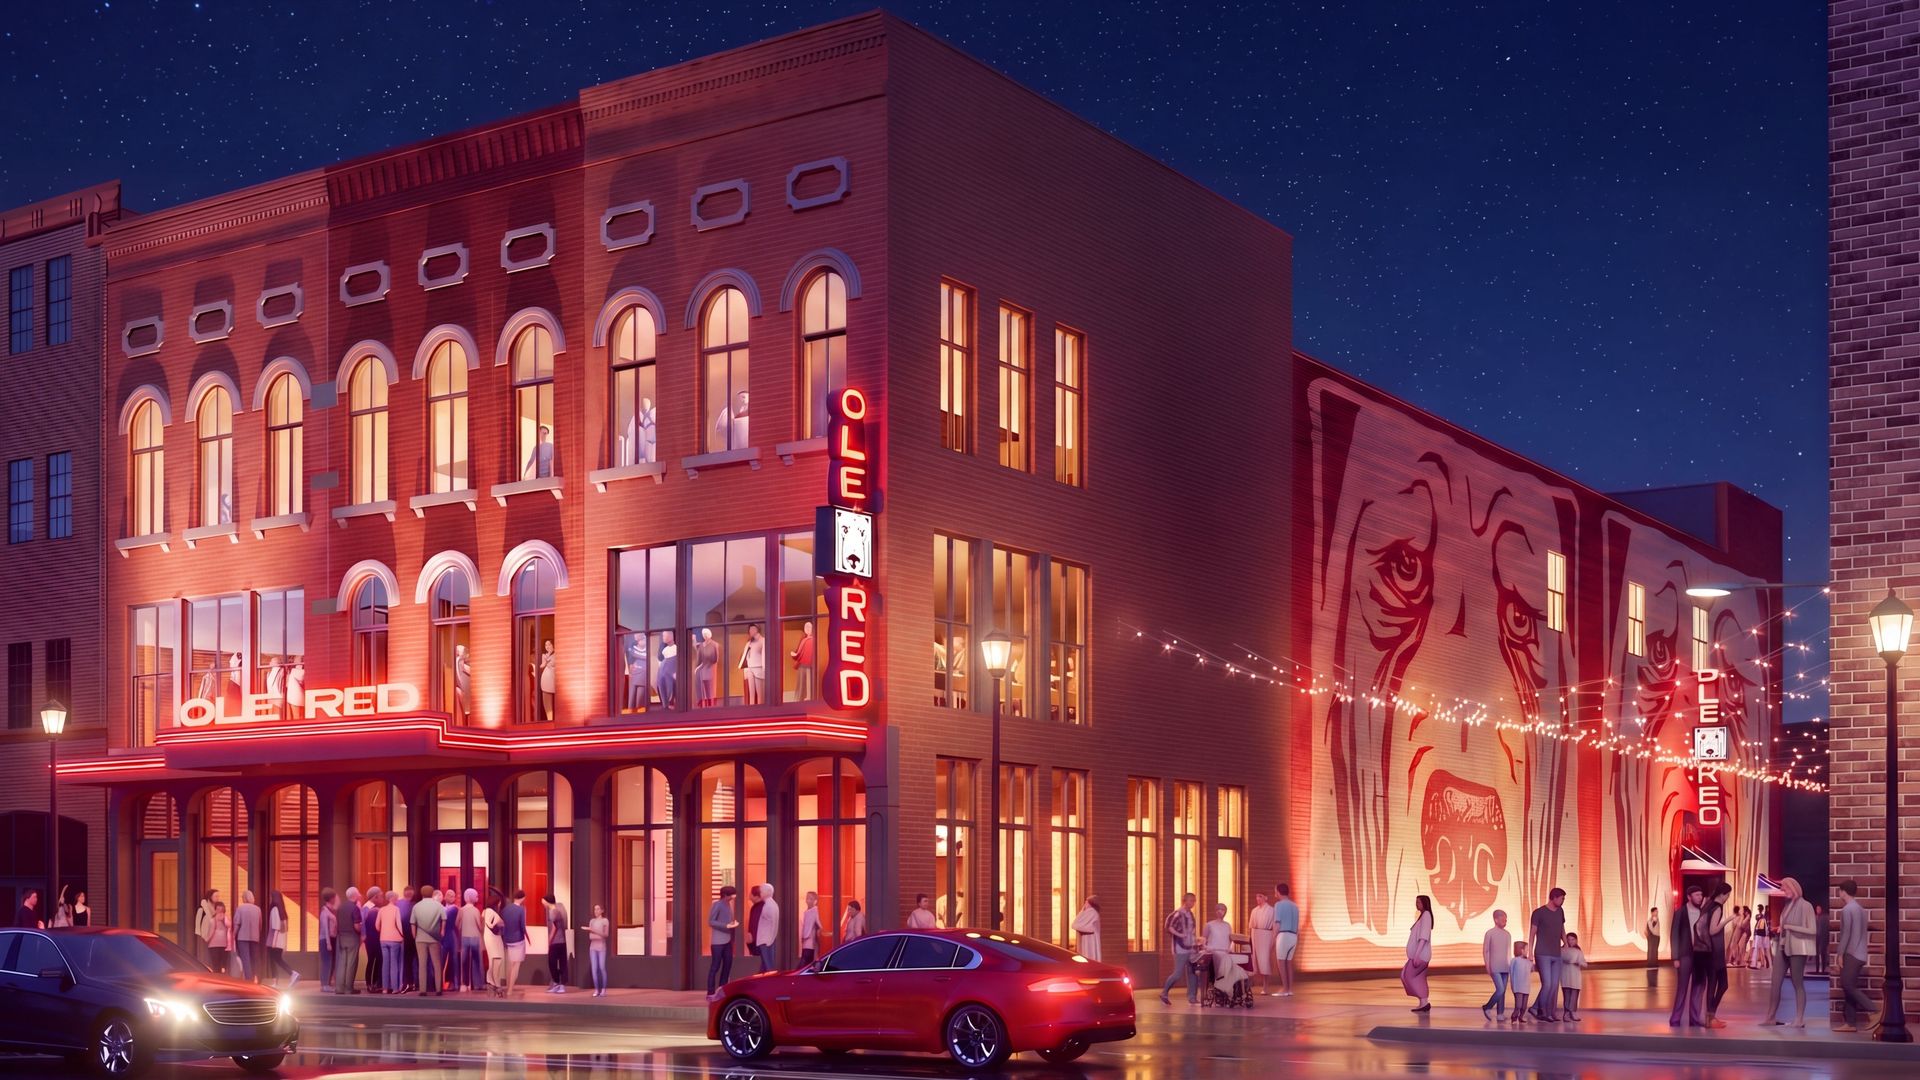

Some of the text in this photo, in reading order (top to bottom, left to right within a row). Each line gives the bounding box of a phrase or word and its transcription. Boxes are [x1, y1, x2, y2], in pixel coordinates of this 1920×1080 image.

[840, 389, 870, 707] OLE RED
[180, 682, 420, 727] OLE RED
